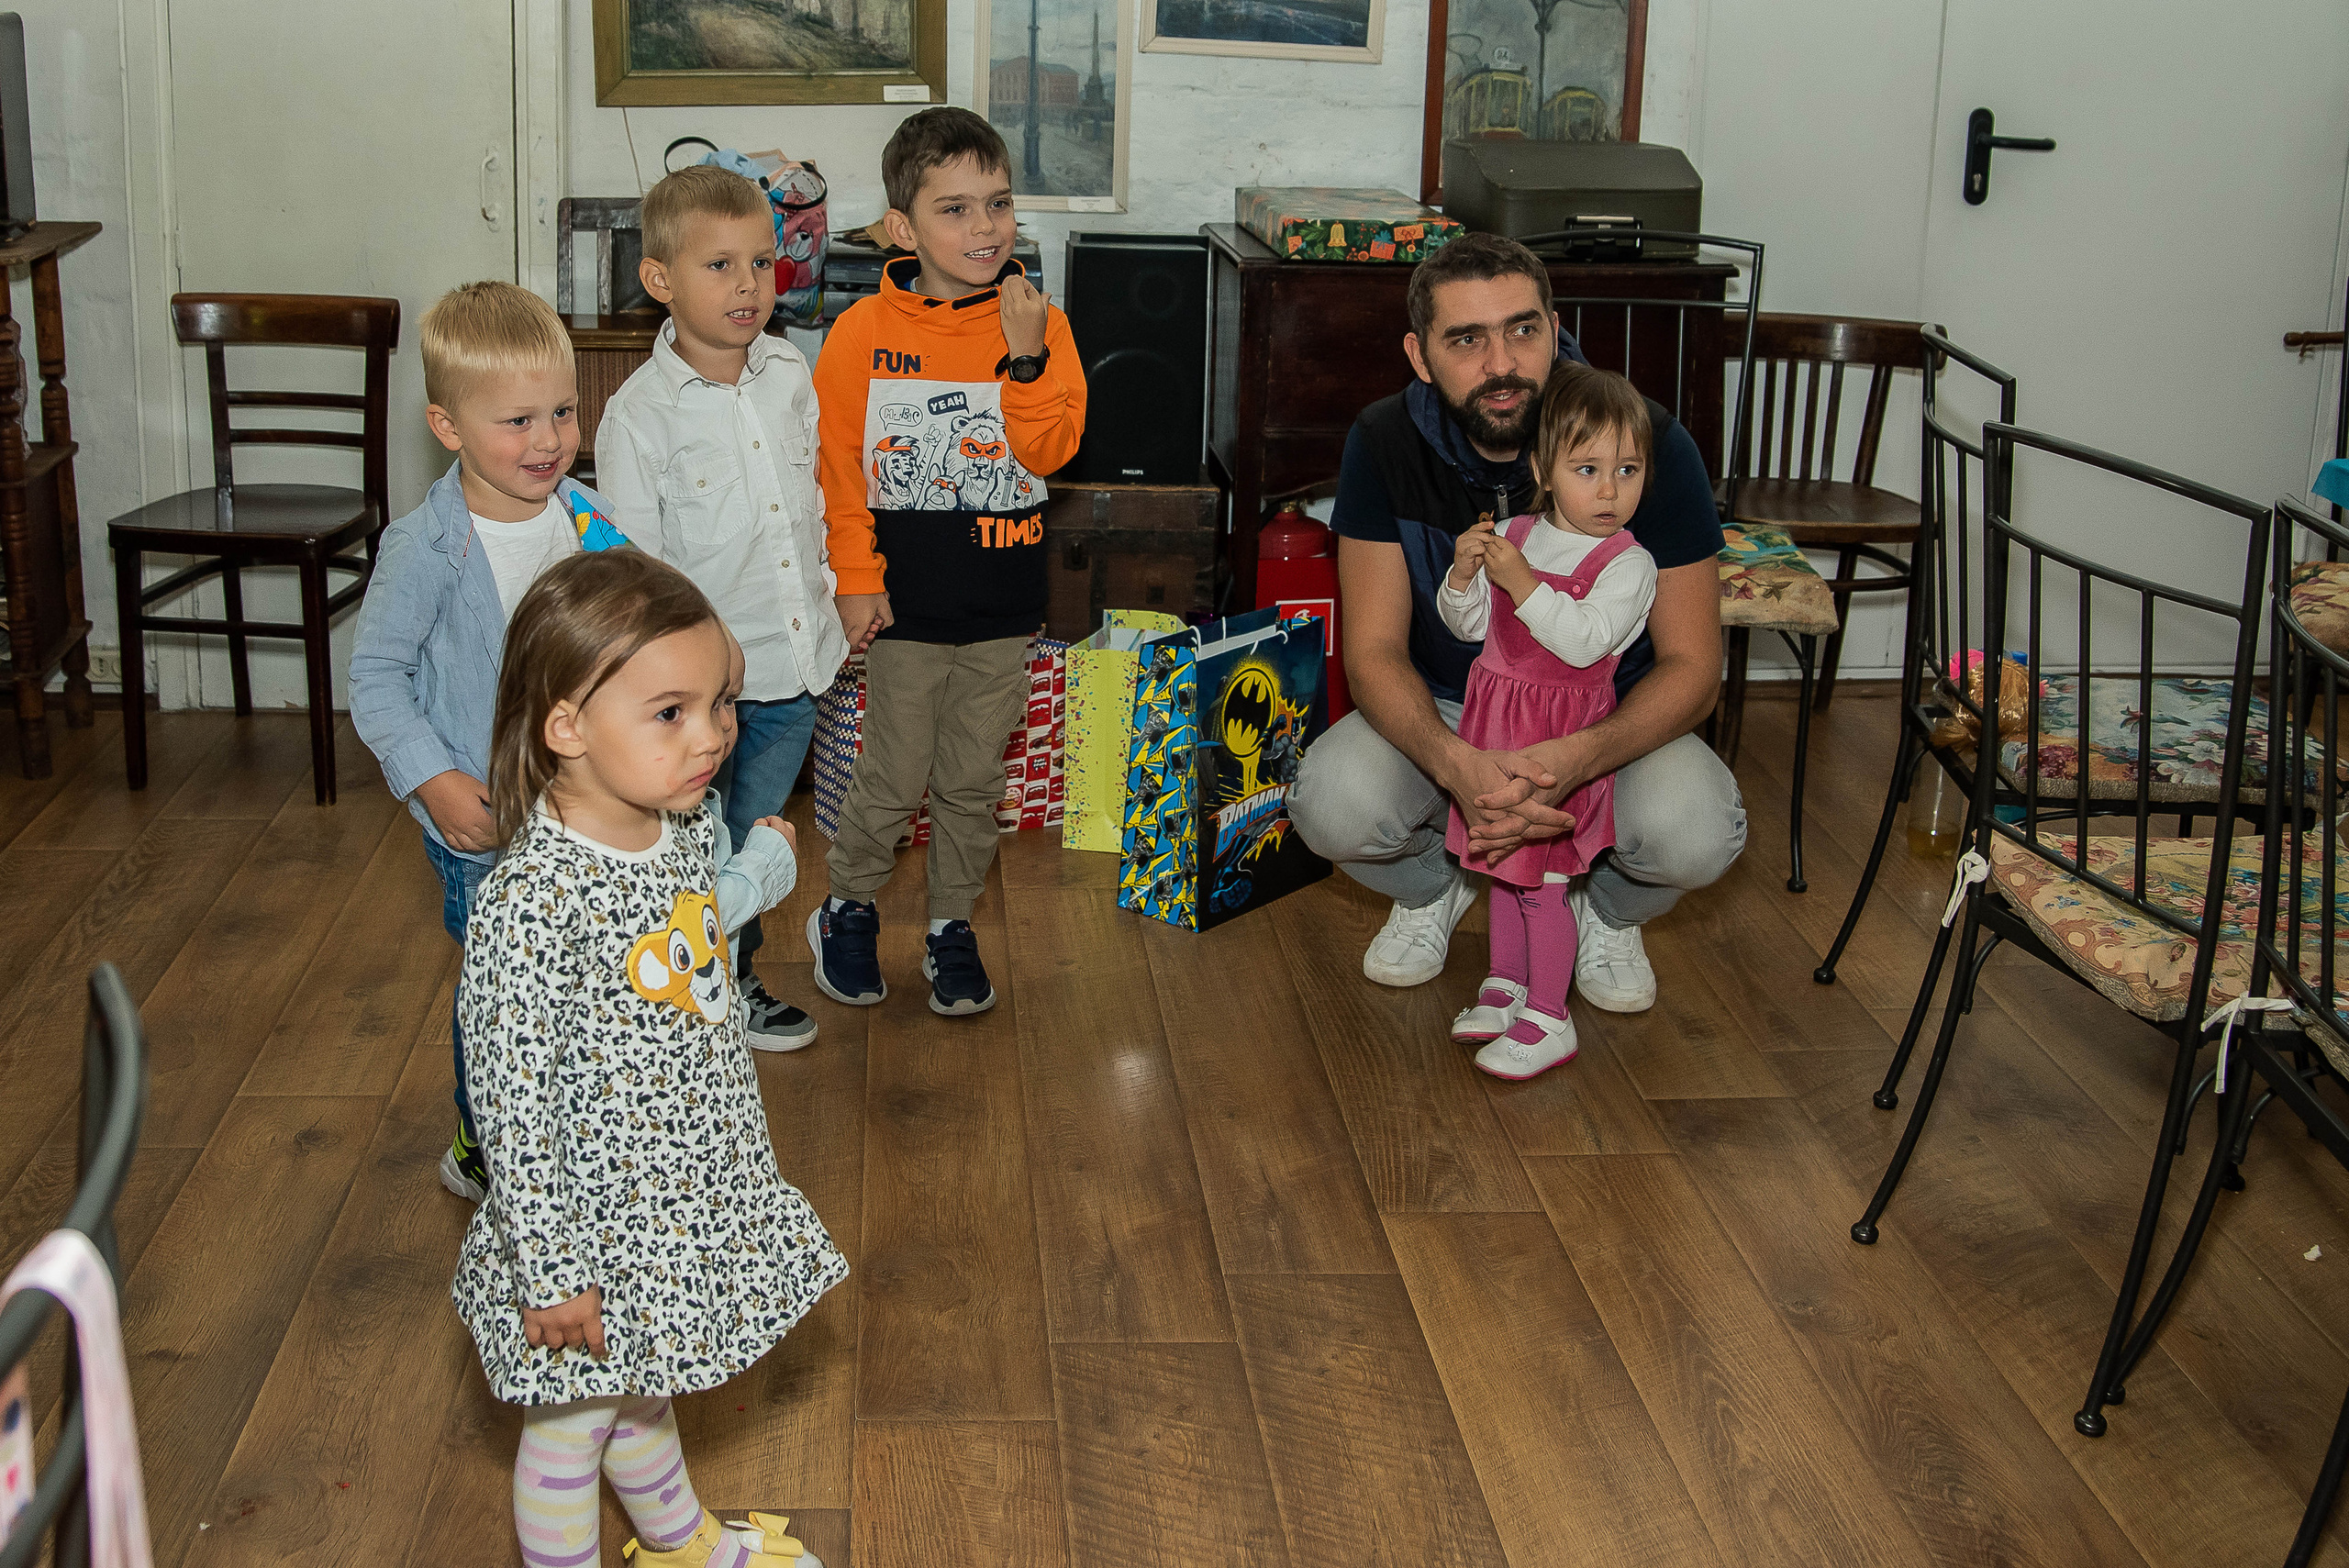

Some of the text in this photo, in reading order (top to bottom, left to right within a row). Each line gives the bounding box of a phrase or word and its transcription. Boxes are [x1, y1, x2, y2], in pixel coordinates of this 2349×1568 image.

[873, 349, 921, 374] FUN
[930, 395, 964, 413] YEAH
[976, 512, 1043, 548] TIMES
[1216, 785, 1286, 858] BATMAN
